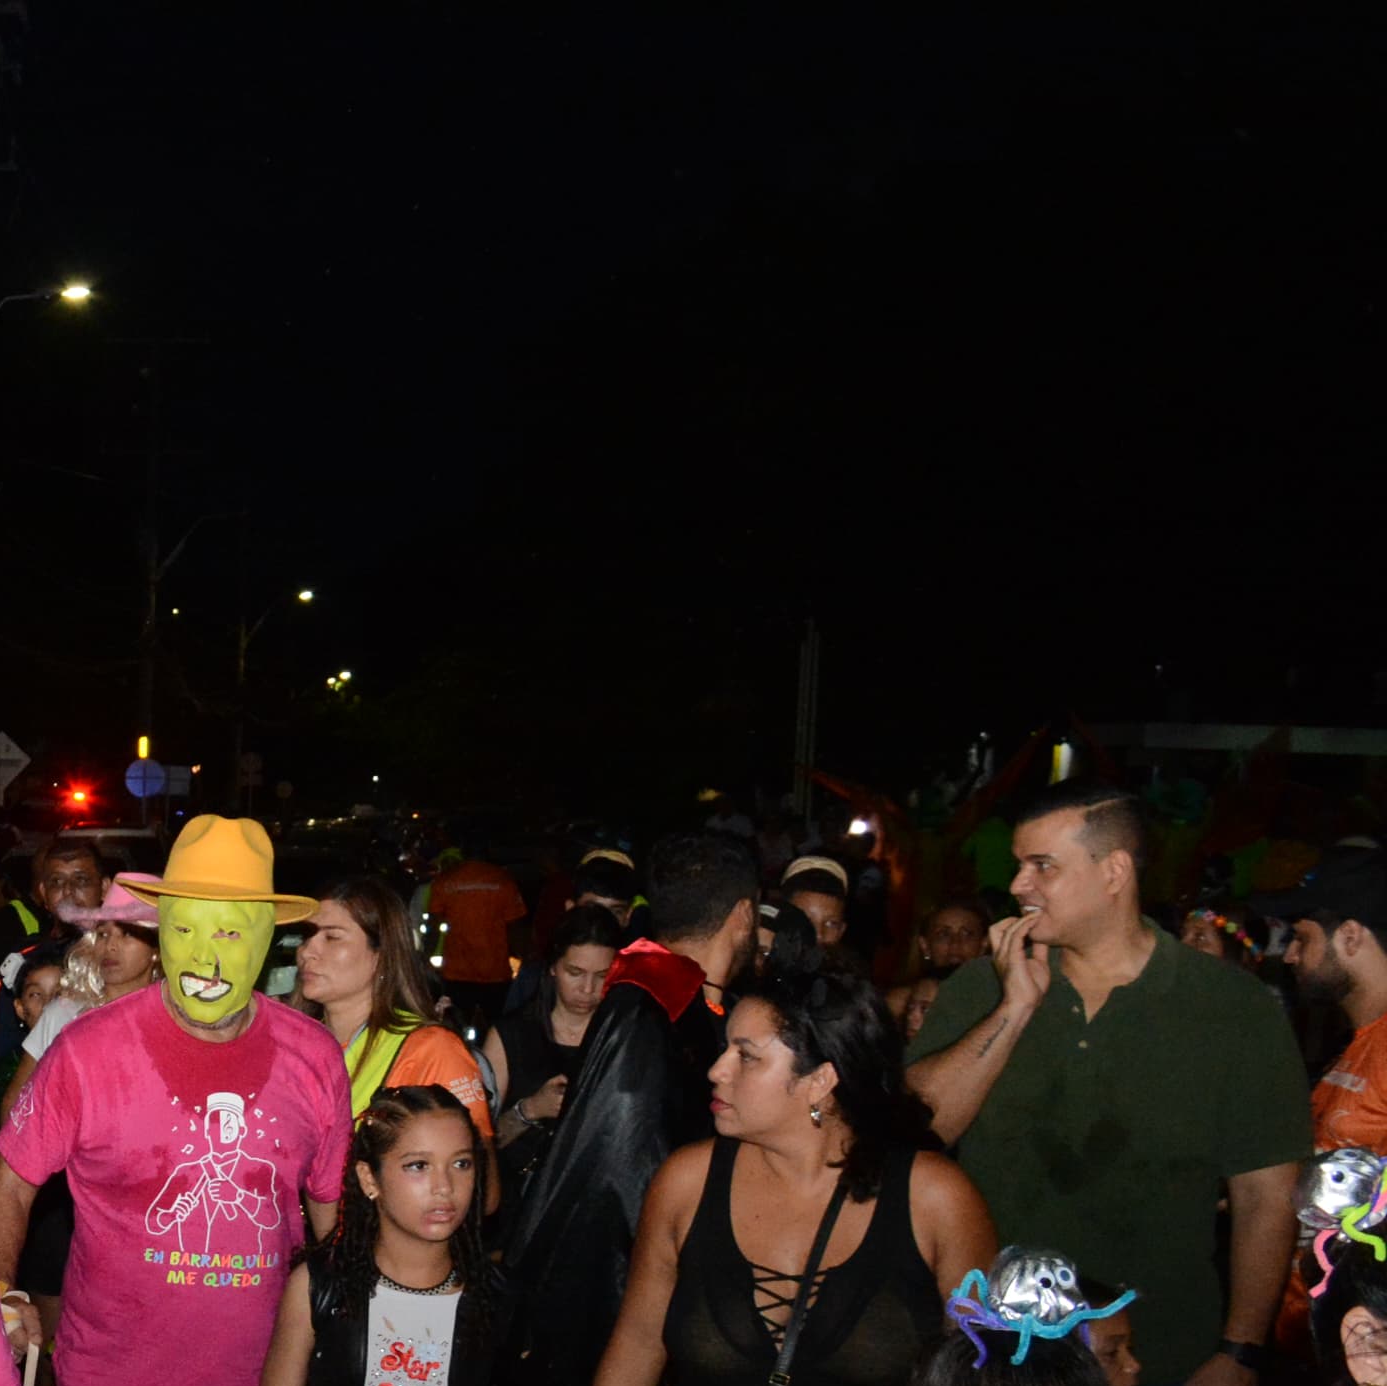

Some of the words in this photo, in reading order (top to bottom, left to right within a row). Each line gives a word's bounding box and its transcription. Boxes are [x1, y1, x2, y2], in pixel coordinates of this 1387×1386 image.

[144, 1248, 164, 1264] EN
[167, 1270, 198, 1285] ME
[203, 1272, 261, 1287] QUEDO
